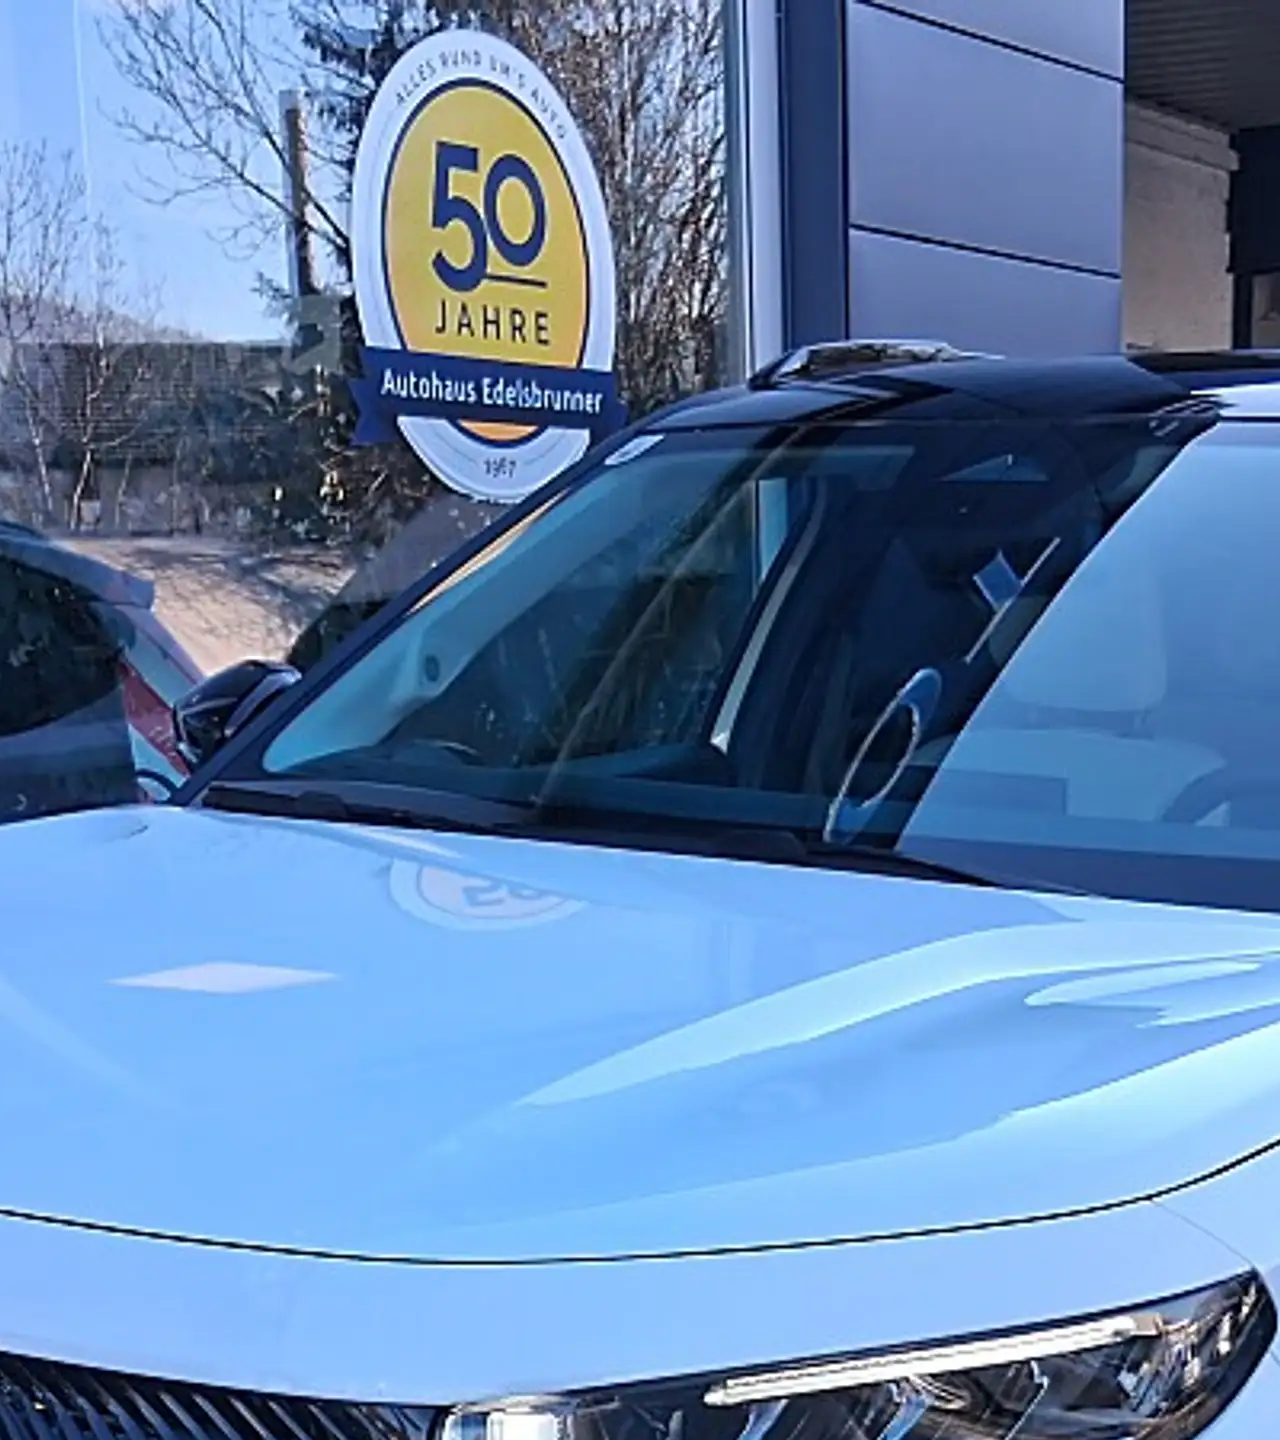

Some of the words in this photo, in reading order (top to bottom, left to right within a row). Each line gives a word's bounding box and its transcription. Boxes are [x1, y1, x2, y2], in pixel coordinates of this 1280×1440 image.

[432, 140, 546, 293] 50
[435, 299, 550, 346] JAHRE
[381, 368, 476, 403] Autohaus
[482, 377, 604, 414] Edelsbrunner
